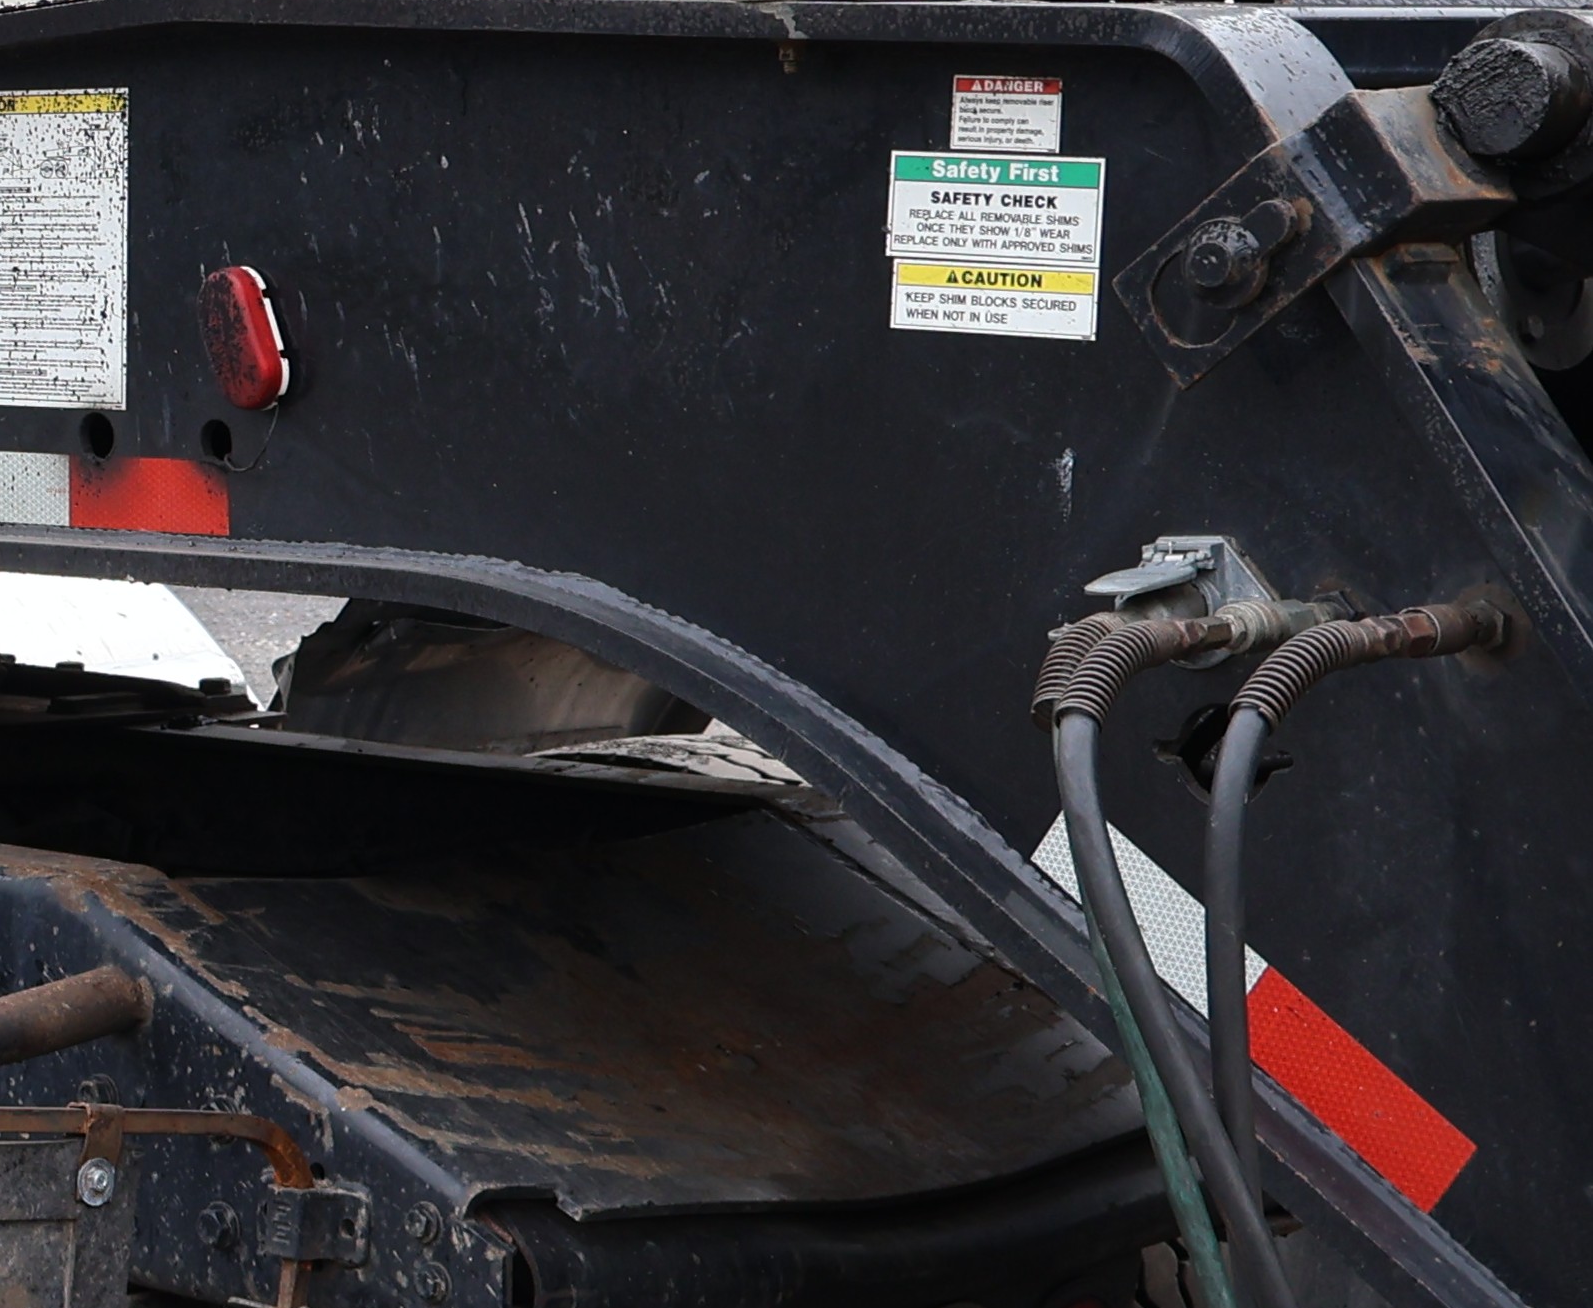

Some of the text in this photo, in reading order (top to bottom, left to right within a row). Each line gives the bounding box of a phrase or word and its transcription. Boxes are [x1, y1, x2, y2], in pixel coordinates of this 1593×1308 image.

[983, 79, 1045, 93] DANGER
[960, 95, 984, 105] Always
[985, 97, 1001, 106] keep
[1002, 97, 1037, 106] removable
[979, 107, 1004, 115] secure.
[958, 115, 1030, 126] Failure to comply can
[958, 125, 979, 133] result
[986, 127, 1015, 136] property
[1016, 128, 1045, 137] damage,
[958, 135, 982, 143] serious
[932, 159, 1060, 183] Safety First
[930, 191, 1058, 209] SAFETY CHECK
[909, 208, 1080, 227] REPLACE ALL REMOVABLE SHIMS
[916, 222, 945, 234] ONCE
[949, 223, 975, 234] THEY
[979, 225, 1010, 237] SHOW
[1040, 228, 1071, 240] WEAR
[893, 234, 1094, 255] REPLACE ONLY WITH APPROVED SHIMS
[961, 270, 1043, 288] CAUTION
[905, 291, 1077, 312] KEEP SHIM BLOCKS SECURED
[905, 308, 1009, 325] WHEN NOT IN USE
